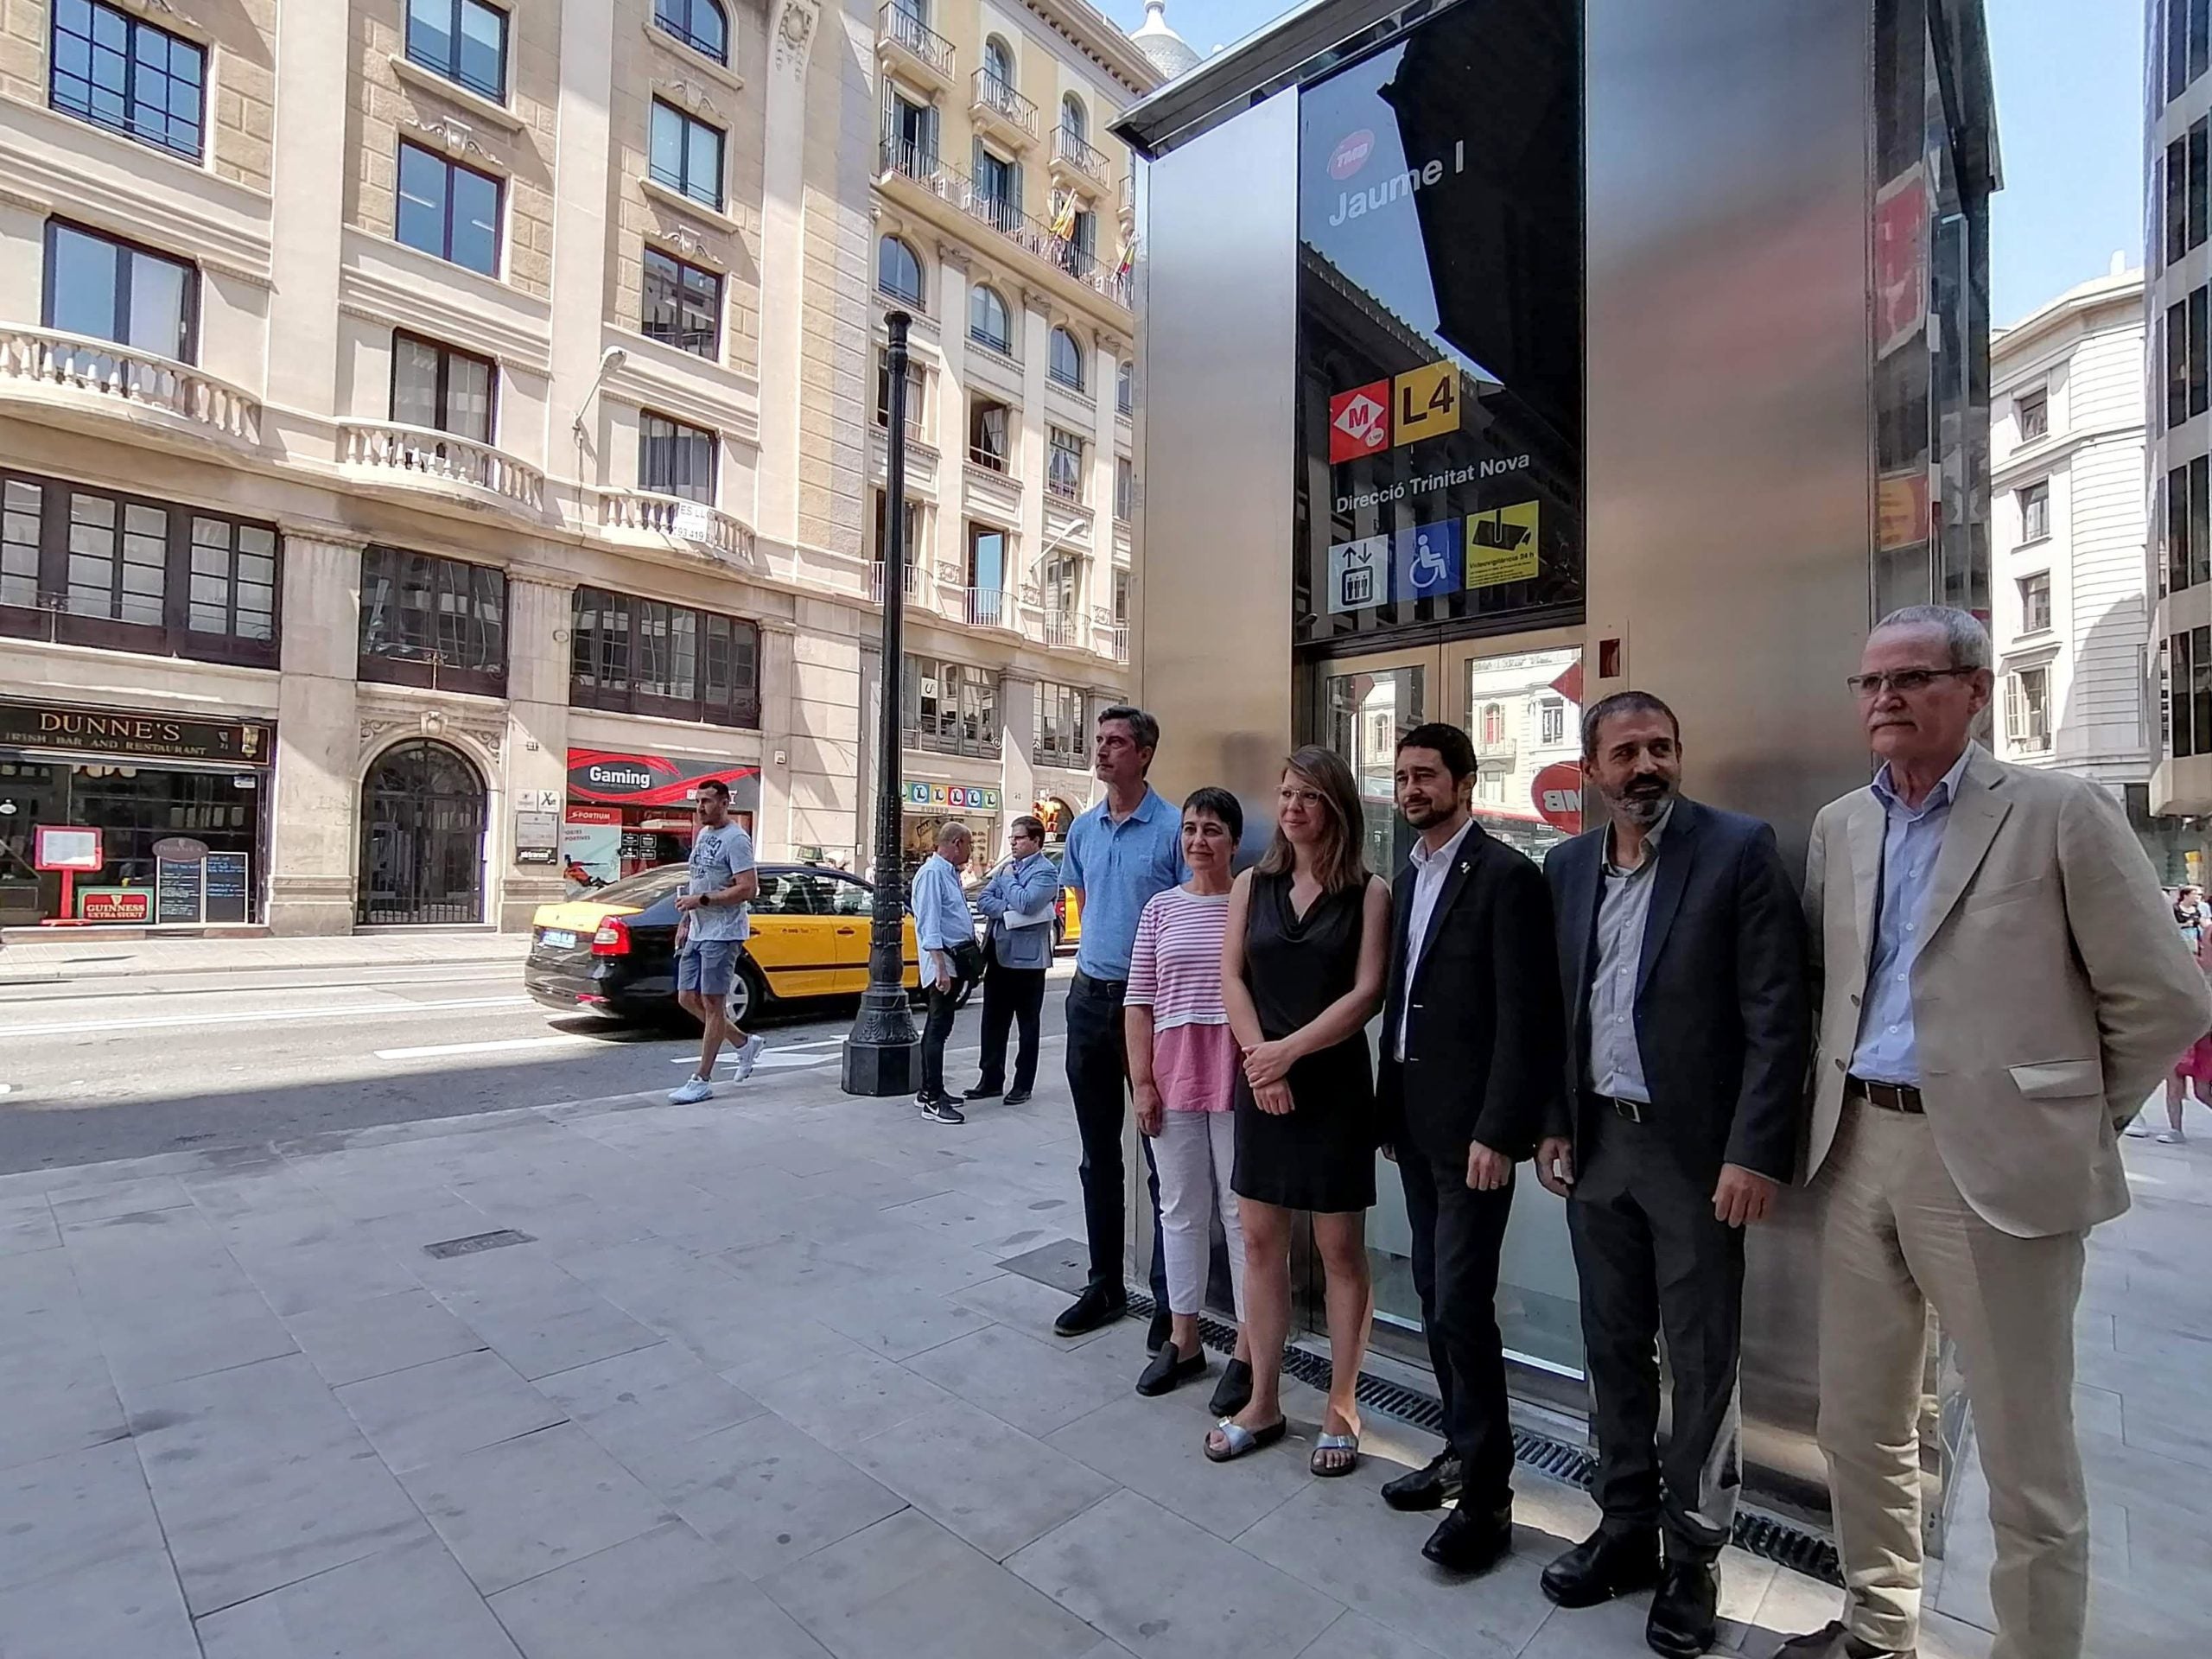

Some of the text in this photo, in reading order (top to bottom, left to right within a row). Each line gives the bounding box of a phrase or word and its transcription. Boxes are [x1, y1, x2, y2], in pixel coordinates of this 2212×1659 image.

[1329, 140, 1464, 226] Jaume I
[1402, 375, 1455, 425] L4
[1349, 404, 1369, 429] M
[1336, 454, 1530, 513] Direcció Trinitat Nova
[40, 713, 181, 741] DUNNE'S
[5, 732, 207, 756] IRISH BAR AND RESTAURANT
[589, 766, 651, 789] Gaming
[568, 810, 611, 820] SPORTIUM
[86, 904, 145, 912] GUINNESS
